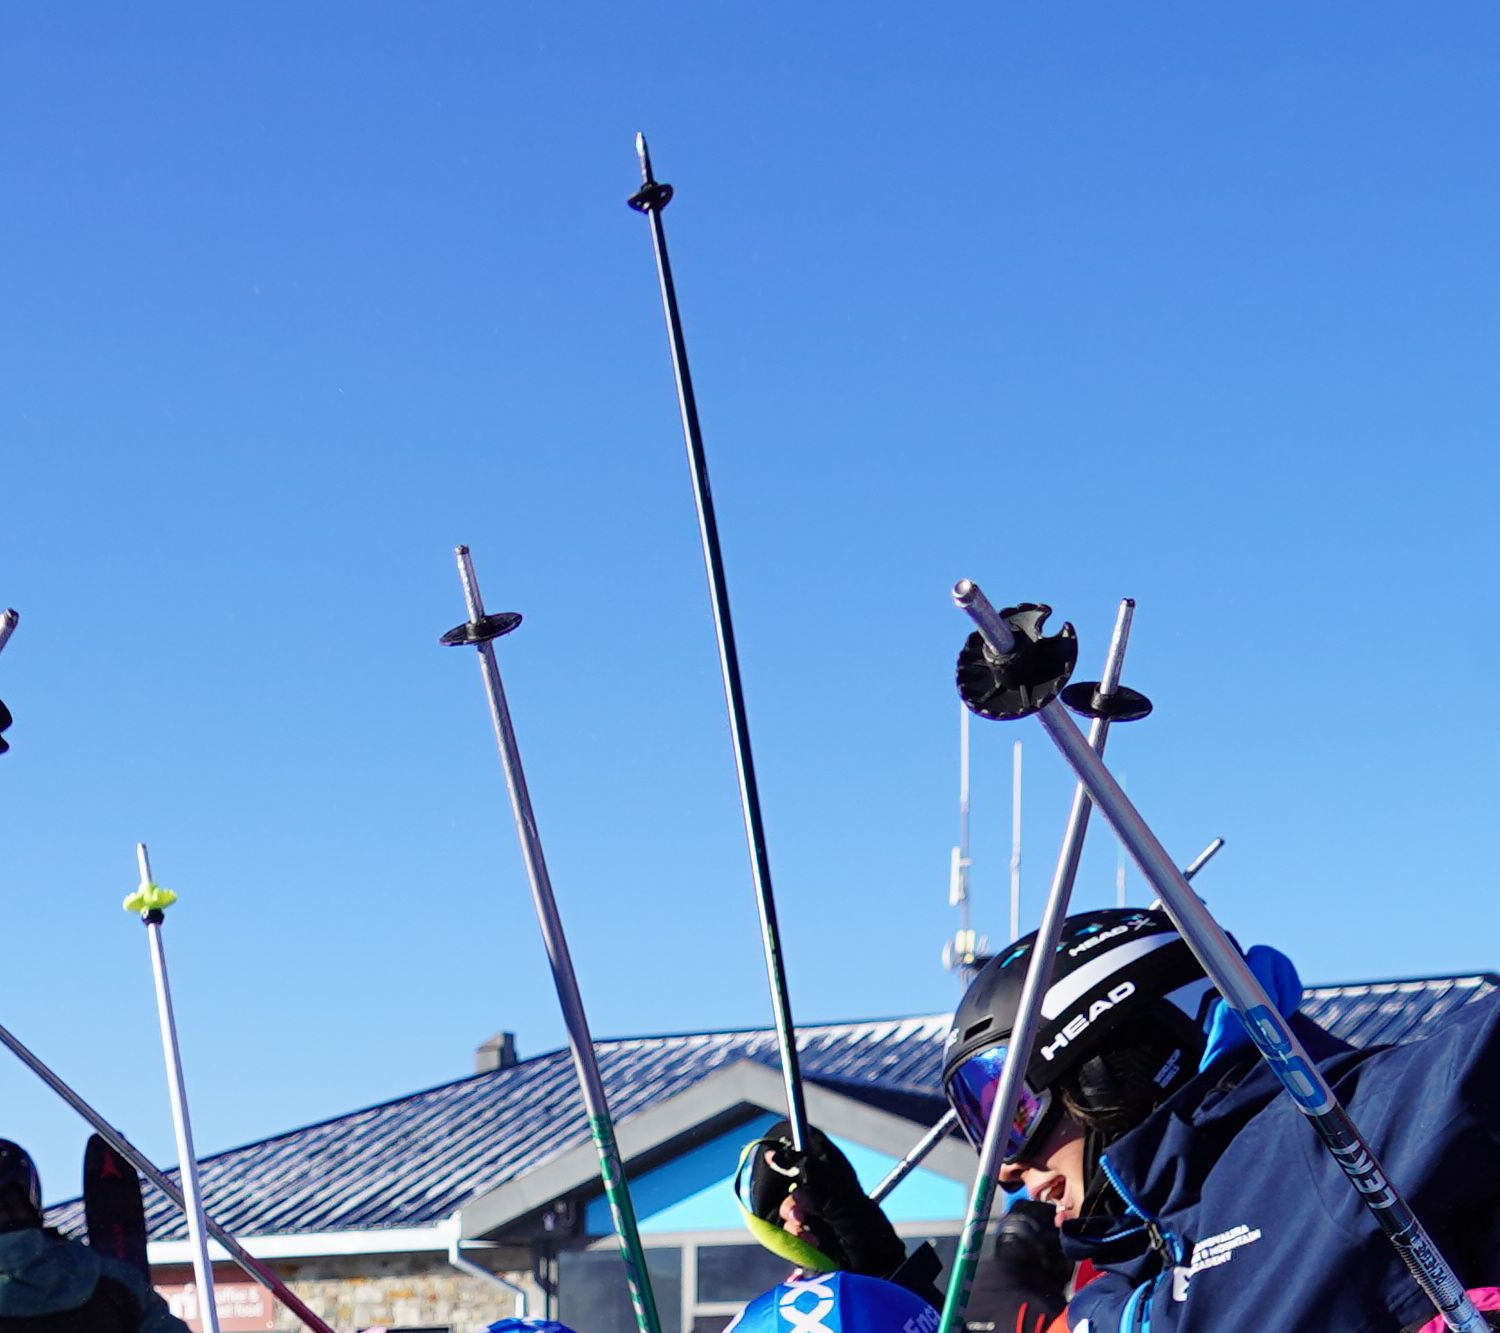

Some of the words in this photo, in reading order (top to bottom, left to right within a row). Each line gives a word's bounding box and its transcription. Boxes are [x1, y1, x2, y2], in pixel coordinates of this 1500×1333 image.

[1068, 925, 1129, 958] HEAD
[1040, 981, 1136, 1061] HEAD
[1329, 1139, 1398, 1210] LEKI
